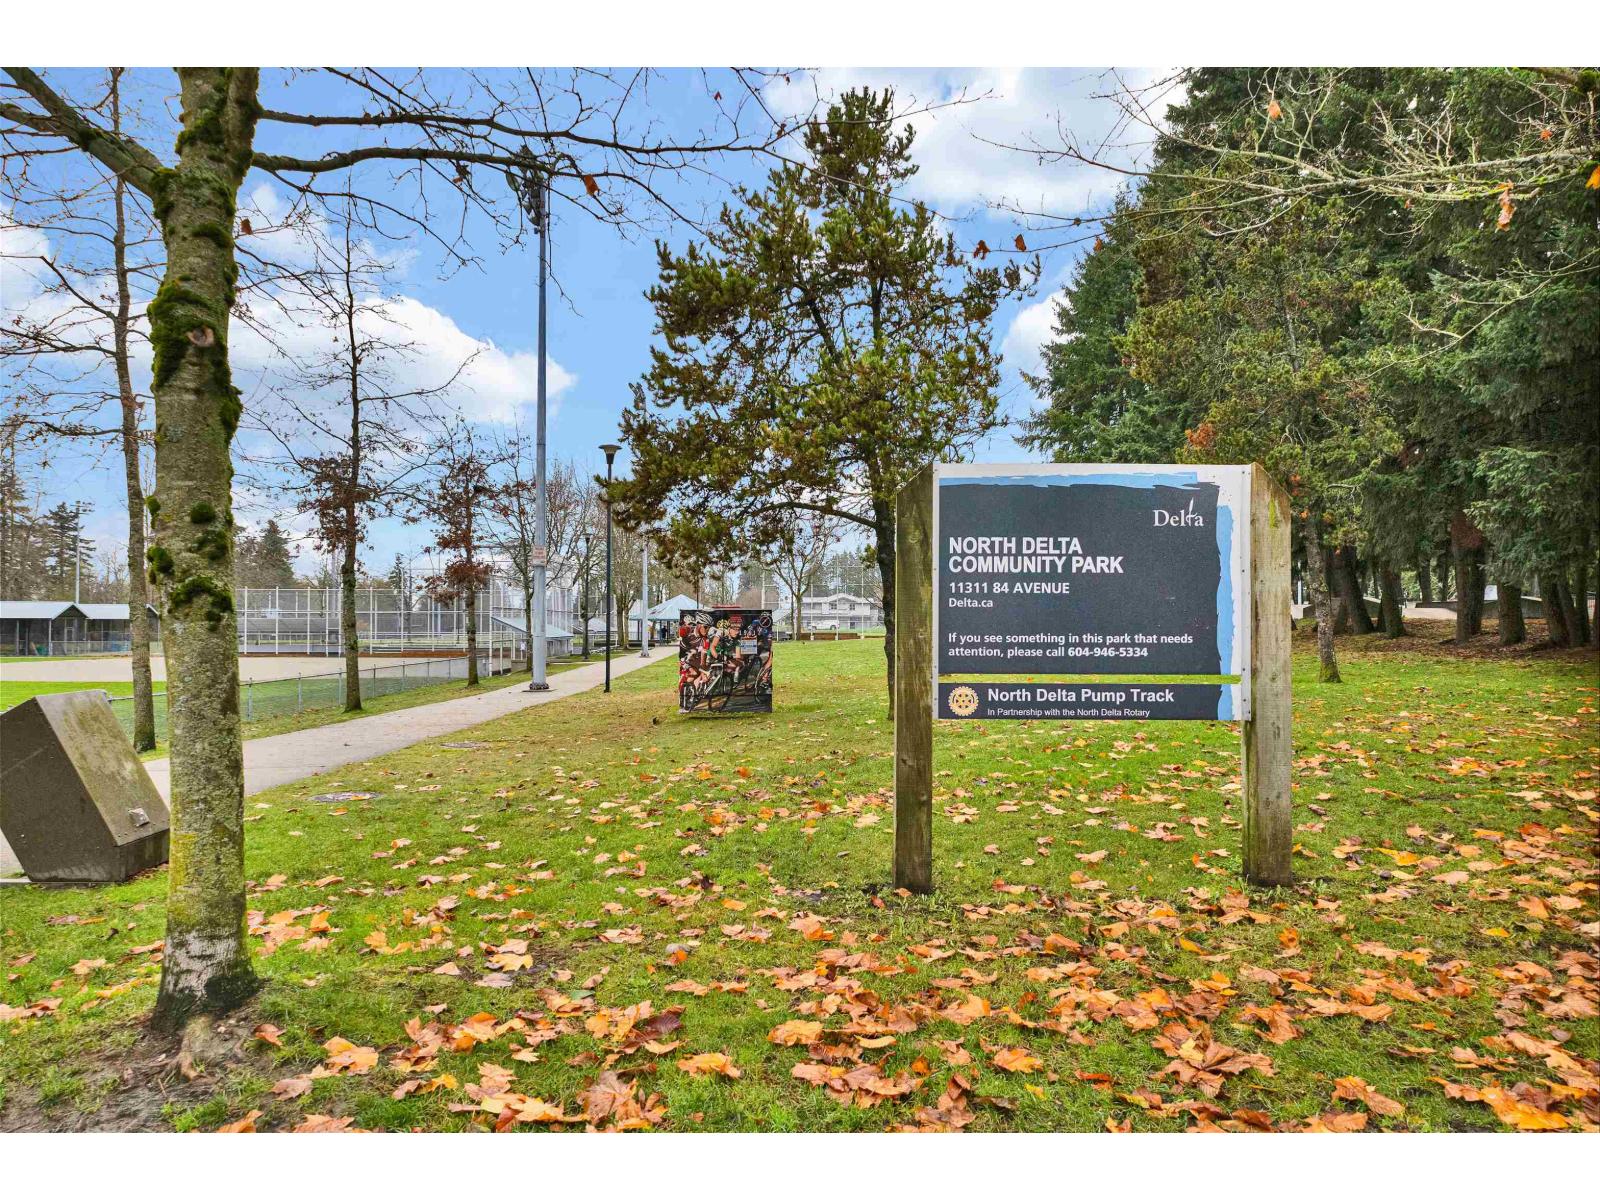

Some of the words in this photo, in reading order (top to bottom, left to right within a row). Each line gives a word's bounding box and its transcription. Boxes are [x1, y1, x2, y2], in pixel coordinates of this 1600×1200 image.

[1153, 497, 1204, 527] Delta
[949, 537, 1016, 555] NORTH
[1022, 537, 1083, 555] DELTA
[948, 556, 1066, 574] COMMUNITY
[1072, 556, 1124, 574] PARK
[949, 582, 988, 594] 11311
[993, 582, 1009, 594] 84
[1013, 582, 1070, 595] AVENUE
[948, 597, 994, 608] Delta.ca
[948, 632, 958, 643] If
[960, 635, 980, 646] you
[984, 635, 1002, 643] see
[1005, 633, 1065, 646] something
[1068, 633, 1079, 644] in
[1082, 633, 1103, 644] this
[1105, 633, 1131, 646] park
[1134, 634, 1157, 644] that
[1160, 634, 1194, 644] needs
[948, 647, 1004, 659] attention,
[1007, 647, 1043, 659] please
[1046, 647, 1065, 657] call
[1067, 647, 1149, 658] 604-946-5334
[988, 688, 1031, 702] North
[1037, 688, 1076, 702] Delta
[1081, 688, 1125, 705] Pump
[1130, 688, 1175, 703] Track
[987, 708, 995, 716] In
[997, 708, 1043, 718] Partnership
[1044, 708, 1061, 717] with
[1062, 708, 1075, 717] the
[1077, 708, 1098, 717] North
[1101, 708, 1121, 717] Delta
[1124, 708, 1151, 718] Rotary
